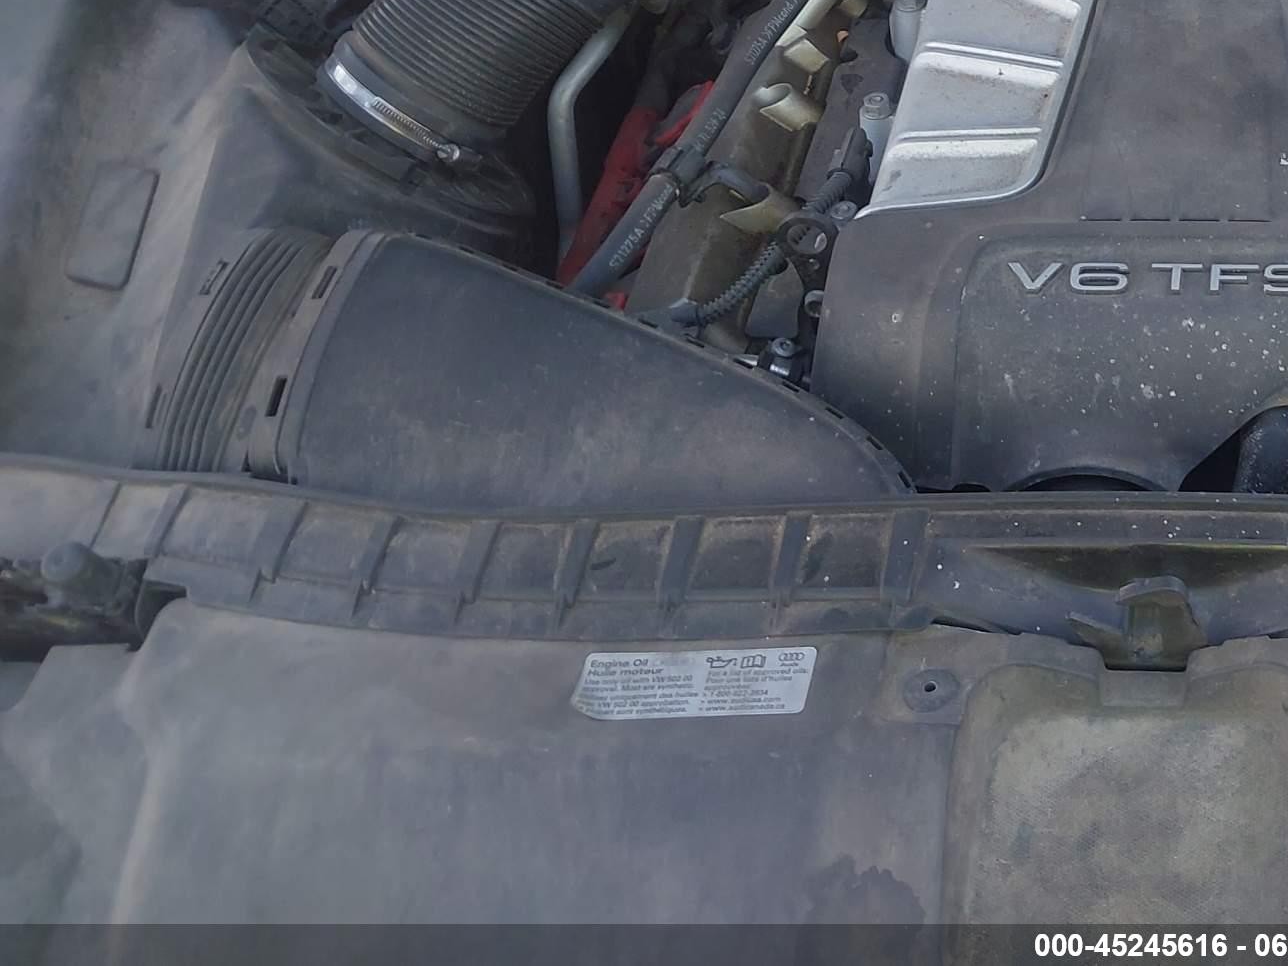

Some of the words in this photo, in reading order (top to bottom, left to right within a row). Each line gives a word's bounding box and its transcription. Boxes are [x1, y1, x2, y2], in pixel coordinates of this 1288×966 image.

[1007, 262, 1129, 293] V6
[590, 659, 629, 669] Engine
[633, 659, 648, 667] Oil
[620, 668, 665, 676] moteur
